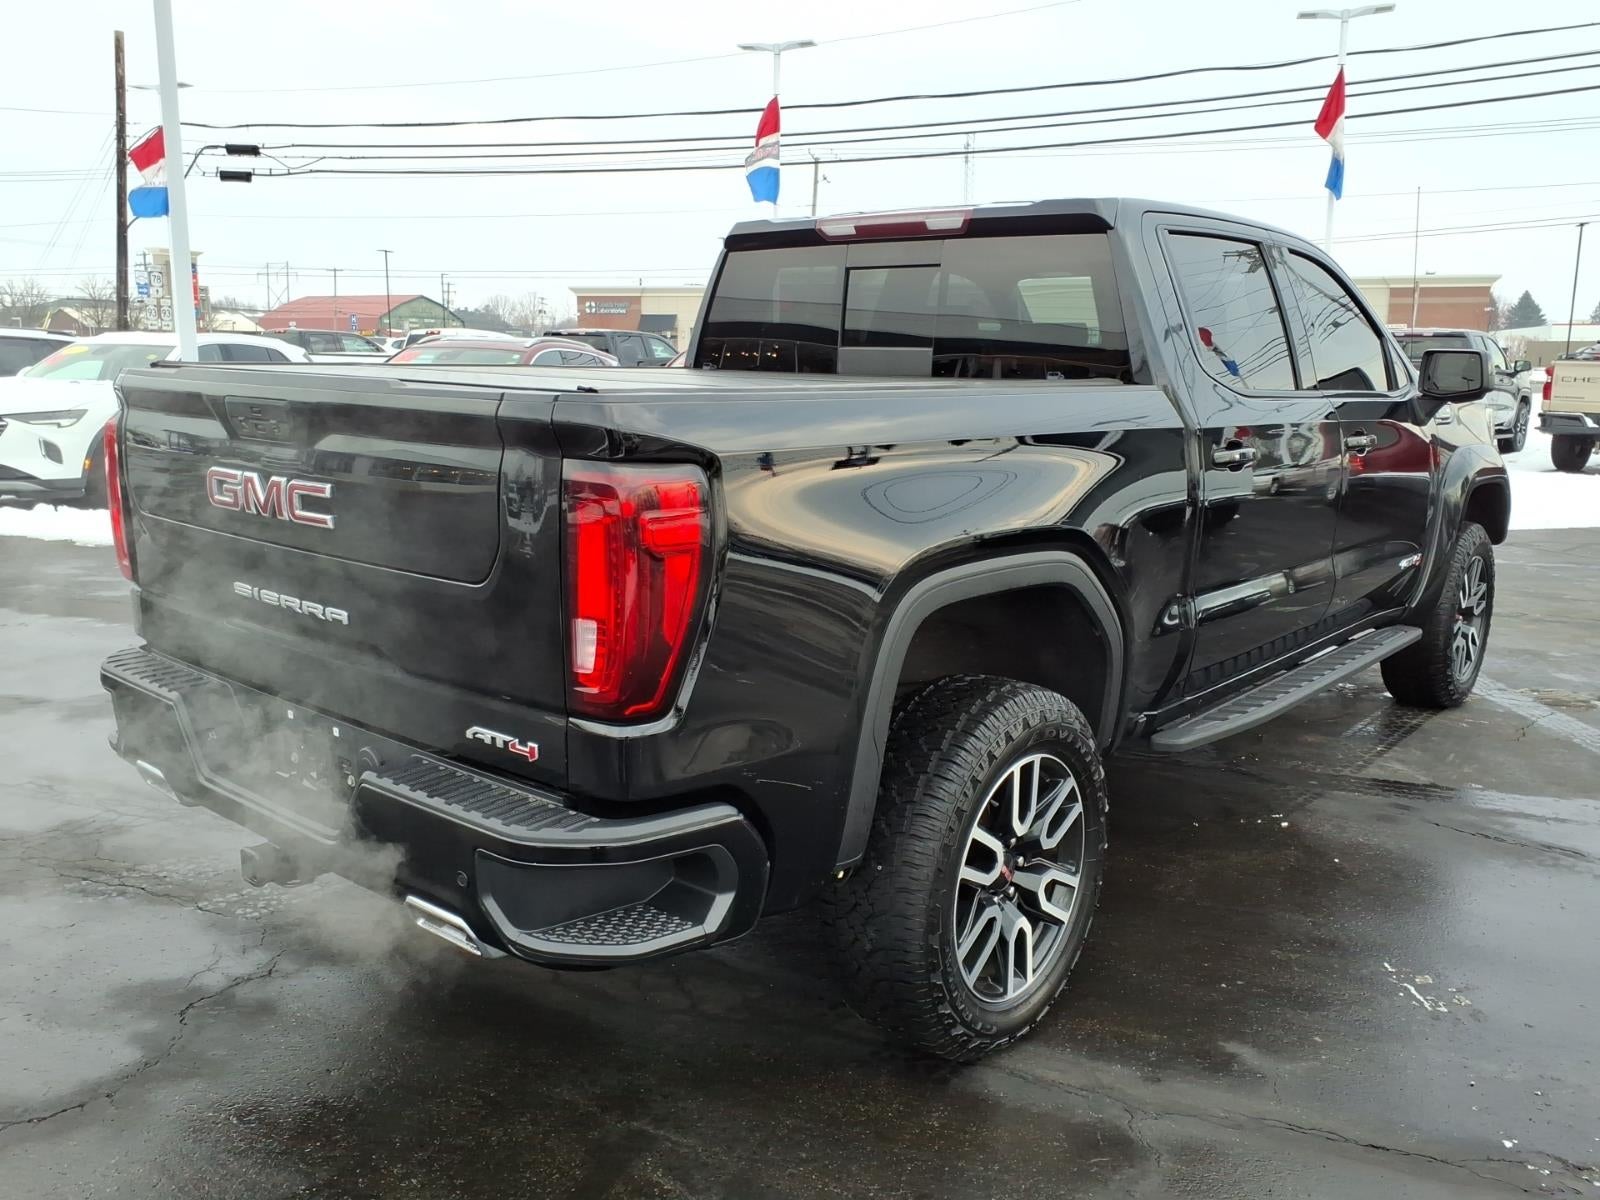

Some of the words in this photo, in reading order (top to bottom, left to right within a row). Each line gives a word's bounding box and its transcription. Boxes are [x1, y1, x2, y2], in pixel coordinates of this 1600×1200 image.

[152, 274, 162, 284] 78
[148, 308, 157, 318] 93
[162, 309, 171, 318] 93
[207, 466, 335, 529] GMC
[233, 581, 349, 625] SIERRA
[466, 726, 539, 763] AT4
